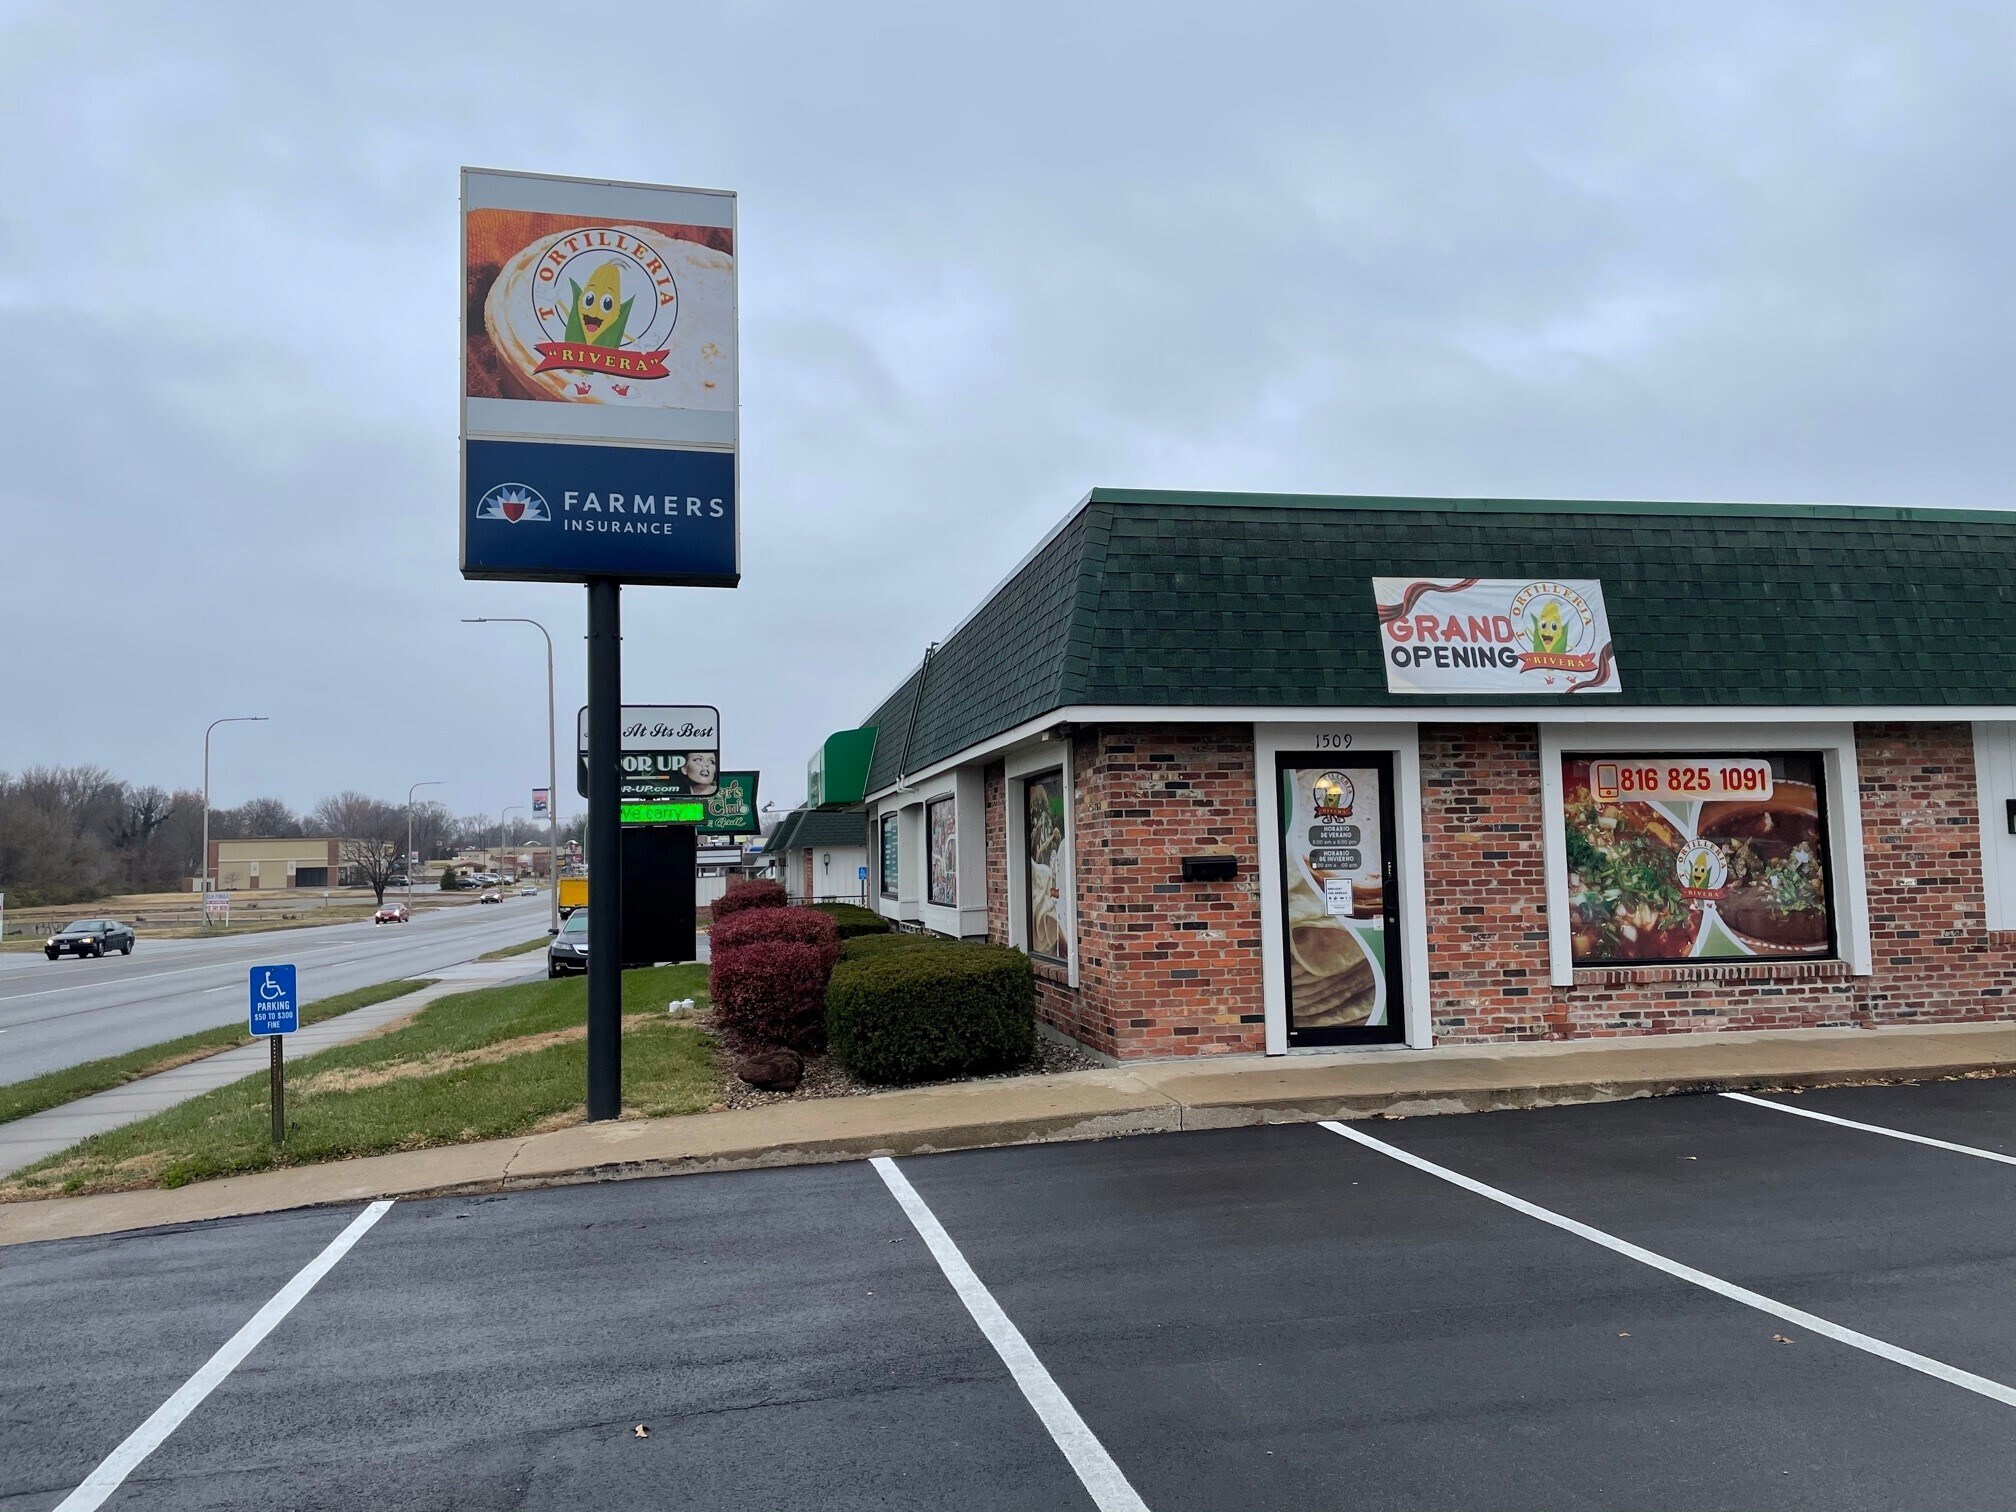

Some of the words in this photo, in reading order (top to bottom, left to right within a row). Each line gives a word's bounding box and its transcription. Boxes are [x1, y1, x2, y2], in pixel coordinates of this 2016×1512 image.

[538, 232, 675, 321] TORTILLERIA
[564, 491, 724, 518] FARMERS
[564, 519, 673, 535] INSURANCE
[1512, 583, 1592, 640] TORTILLERIA
[1387, 614, 1515, 643] GRAND
[1391, 646, 1518, 668] OPENING
[623, 722, 647, 738] At
[650, 722, 674, 738] Its
[676, 722, 714, 738] Best
[1316, 733, 1352, 749] 1509
[657, 755, 686, 772] UP
[1620, 767, 1658, 791] 816
[1668, 767, 1711, 791] 825
[1719, 767, 1766, 791] 1091
[646, 807, 683, 821] carry
[709, 797, 749, 816] Club
[257, 1001, 290, 1012] PARKING
